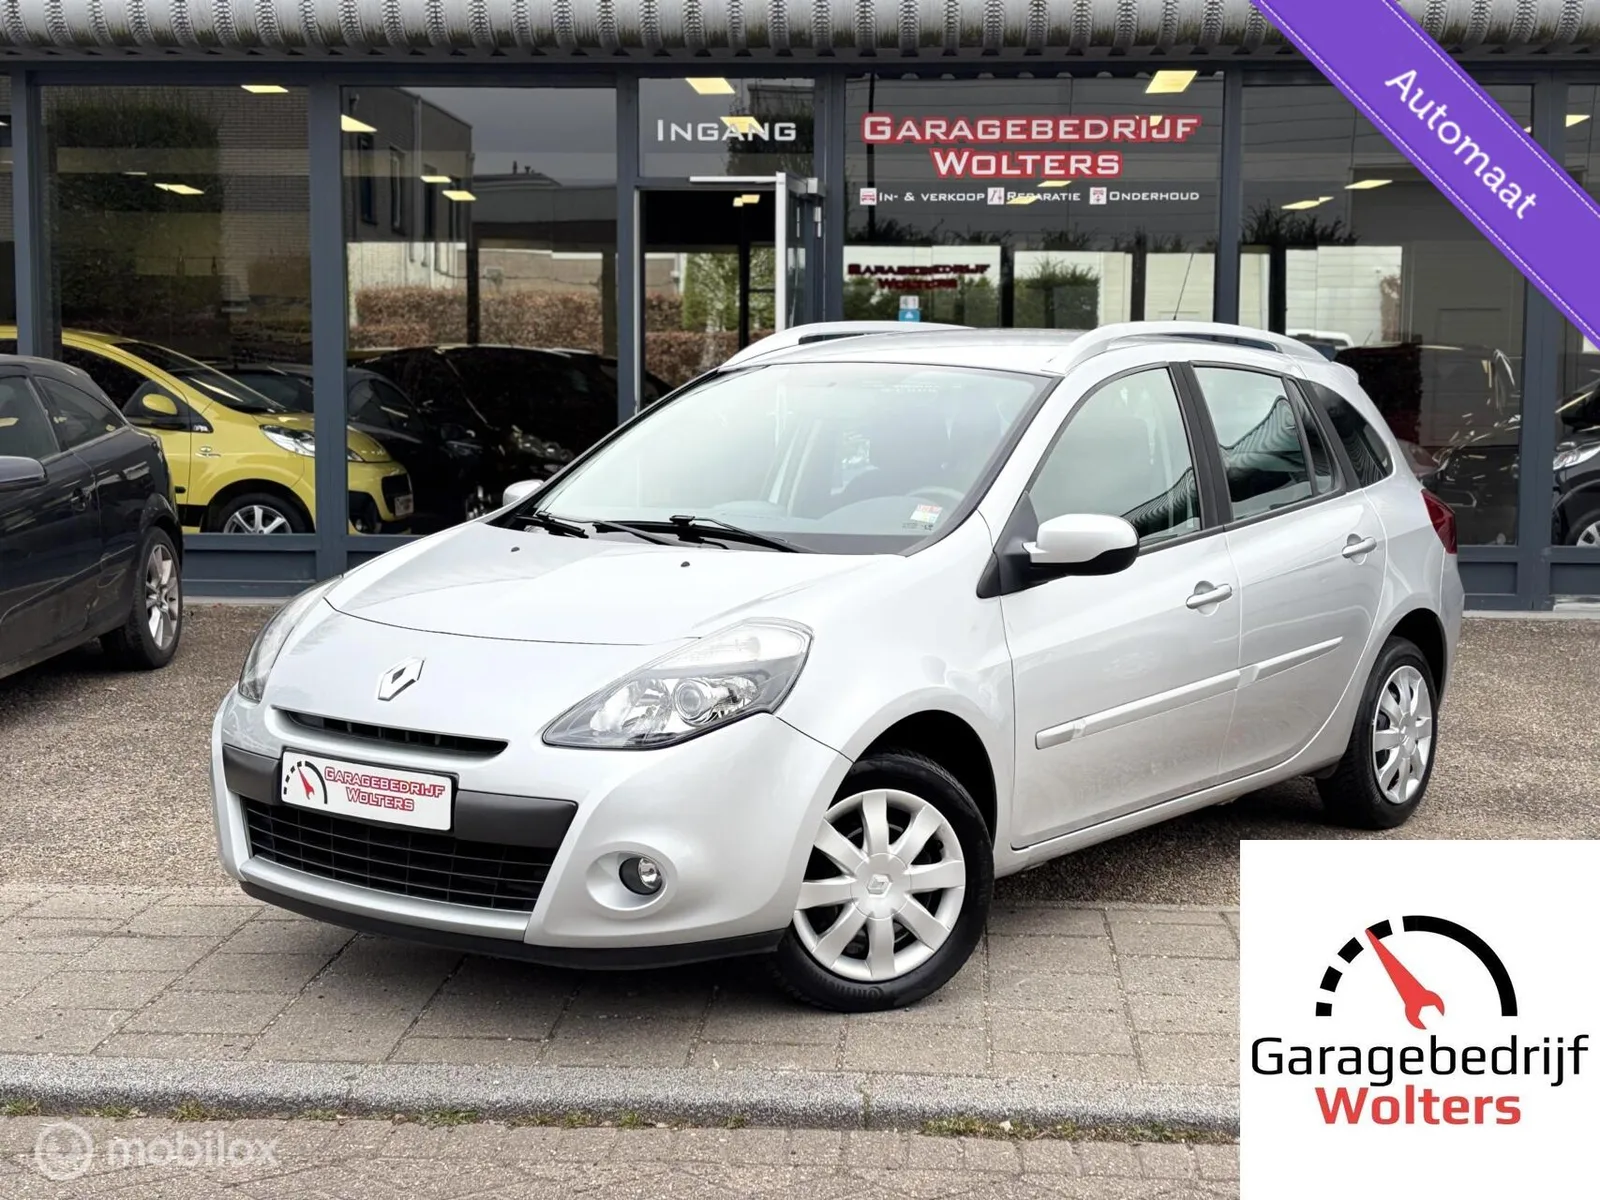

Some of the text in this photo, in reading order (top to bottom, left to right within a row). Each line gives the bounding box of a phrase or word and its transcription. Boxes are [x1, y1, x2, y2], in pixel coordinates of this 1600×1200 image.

[657, 119, 797, 142] INGANG
[862, 114, 1199, 143] GARAGEBEDRIJF
[932, 150, 1121, 177] WOLTERS
[904, 192, 915, 201] &
[1109, 191, 1200, 201] ONDERHOUD
[324, 766, 445, 798] GARAGEBEDRIJF
[346, 786, 414, 812] WOLTERS
